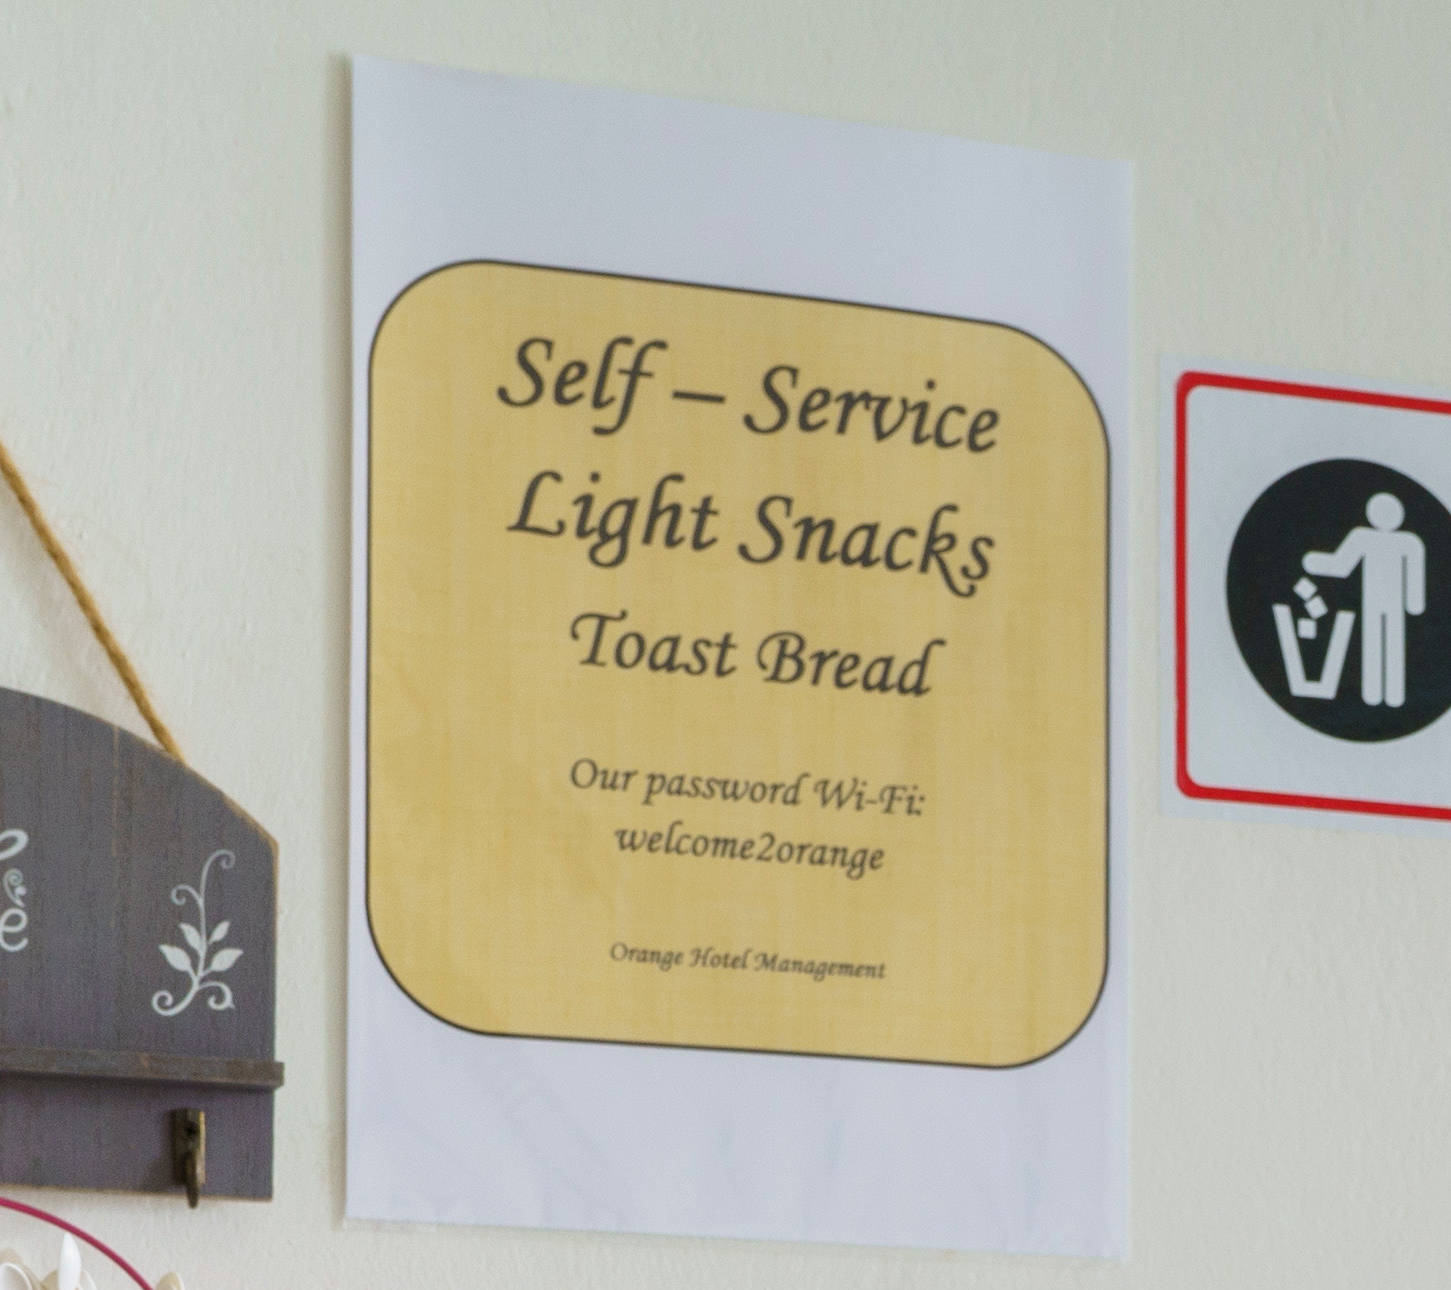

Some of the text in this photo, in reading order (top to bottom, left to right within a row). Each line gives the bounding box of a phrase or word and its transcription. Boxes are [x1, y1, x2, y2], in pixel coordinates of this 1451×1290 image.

[497, 336, 669, 437] Self
[743, 364, 1000, 454] Service
[506, 470, 995, 599] Light Snacks
[570, 609, 947, 698] Toast Bread
[570, 758, 926, 817] Our password Wi-Fi:
[615, 820, 885, 881] welcome2orange
[609, 943, 886, 983] Orange Hotel Management
